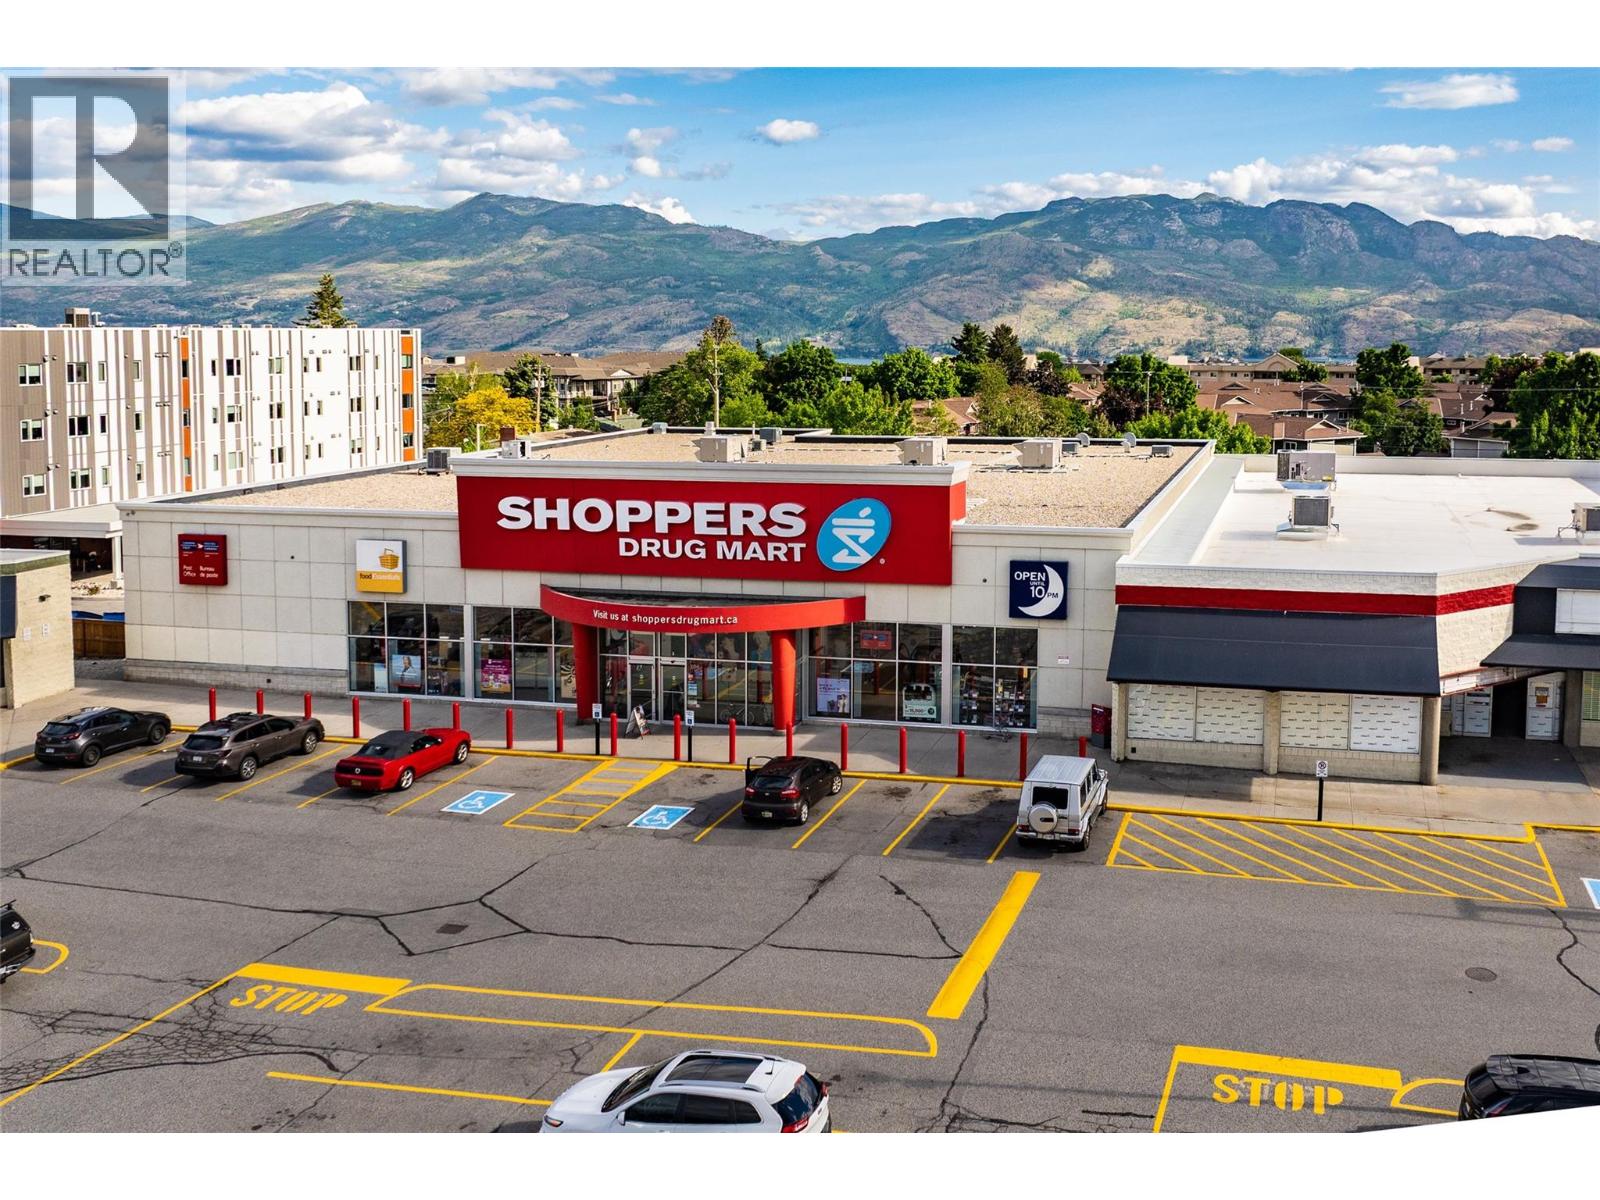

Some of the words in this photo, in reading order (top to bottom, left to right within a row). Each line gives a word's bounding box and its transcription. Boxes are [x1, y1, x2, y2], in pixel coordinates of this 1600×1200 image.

[496, 496, 807, 538] SHOPPERS
[618, 537, 707, 560] DRUG
[716, 541, 806, 563] MART
[1014, 571, 1046, 581] OPEN
[1029, 585, 1045, 599] 10
[592, 609, 608, 620] Visit
[610, 613, 620, 622] us
[621, 613, 629, 622] at
[632, 613, 738, 626] shoppersdrugmart.ca
[229, 984, 349, 1016] STOP
[1212, 1073, 1344, 1115] STOP
